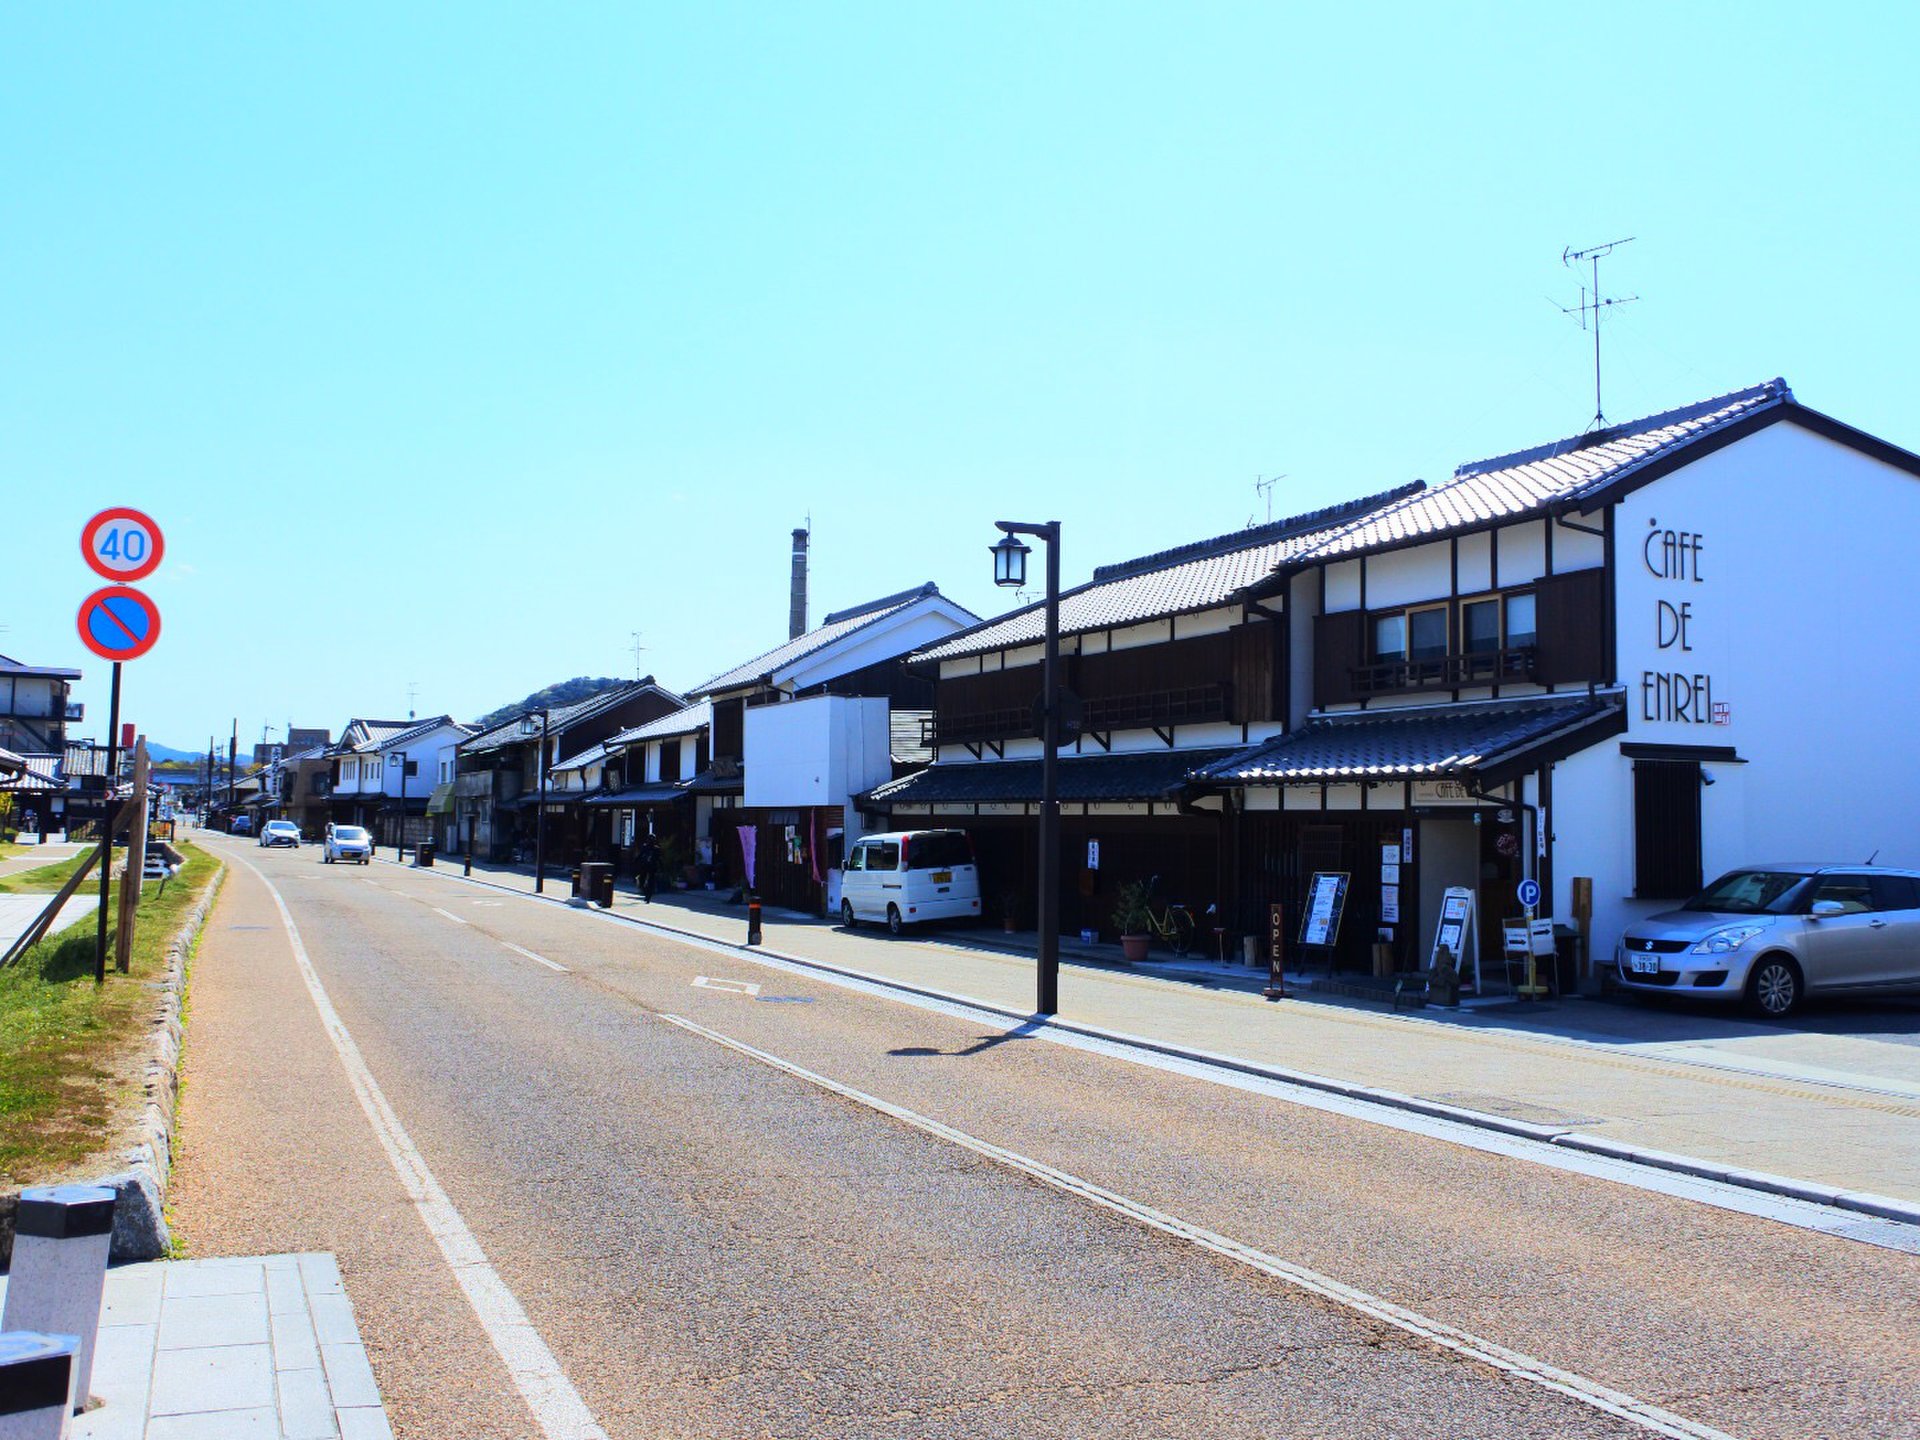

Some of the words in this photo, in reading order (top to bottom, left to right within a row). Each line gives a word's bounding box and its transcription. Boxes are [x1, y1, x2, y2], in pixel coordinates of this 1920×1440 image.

[100, 528, 145, 562] 40
[1644, 530, 1703, 582] CAFE
[1658, 600, 1692, 651] DE
[1643, 671, 1711, 723] ENREI
[1525, 884, 1537, 902] P
[1272, 912, 1281, 973] OPEN
